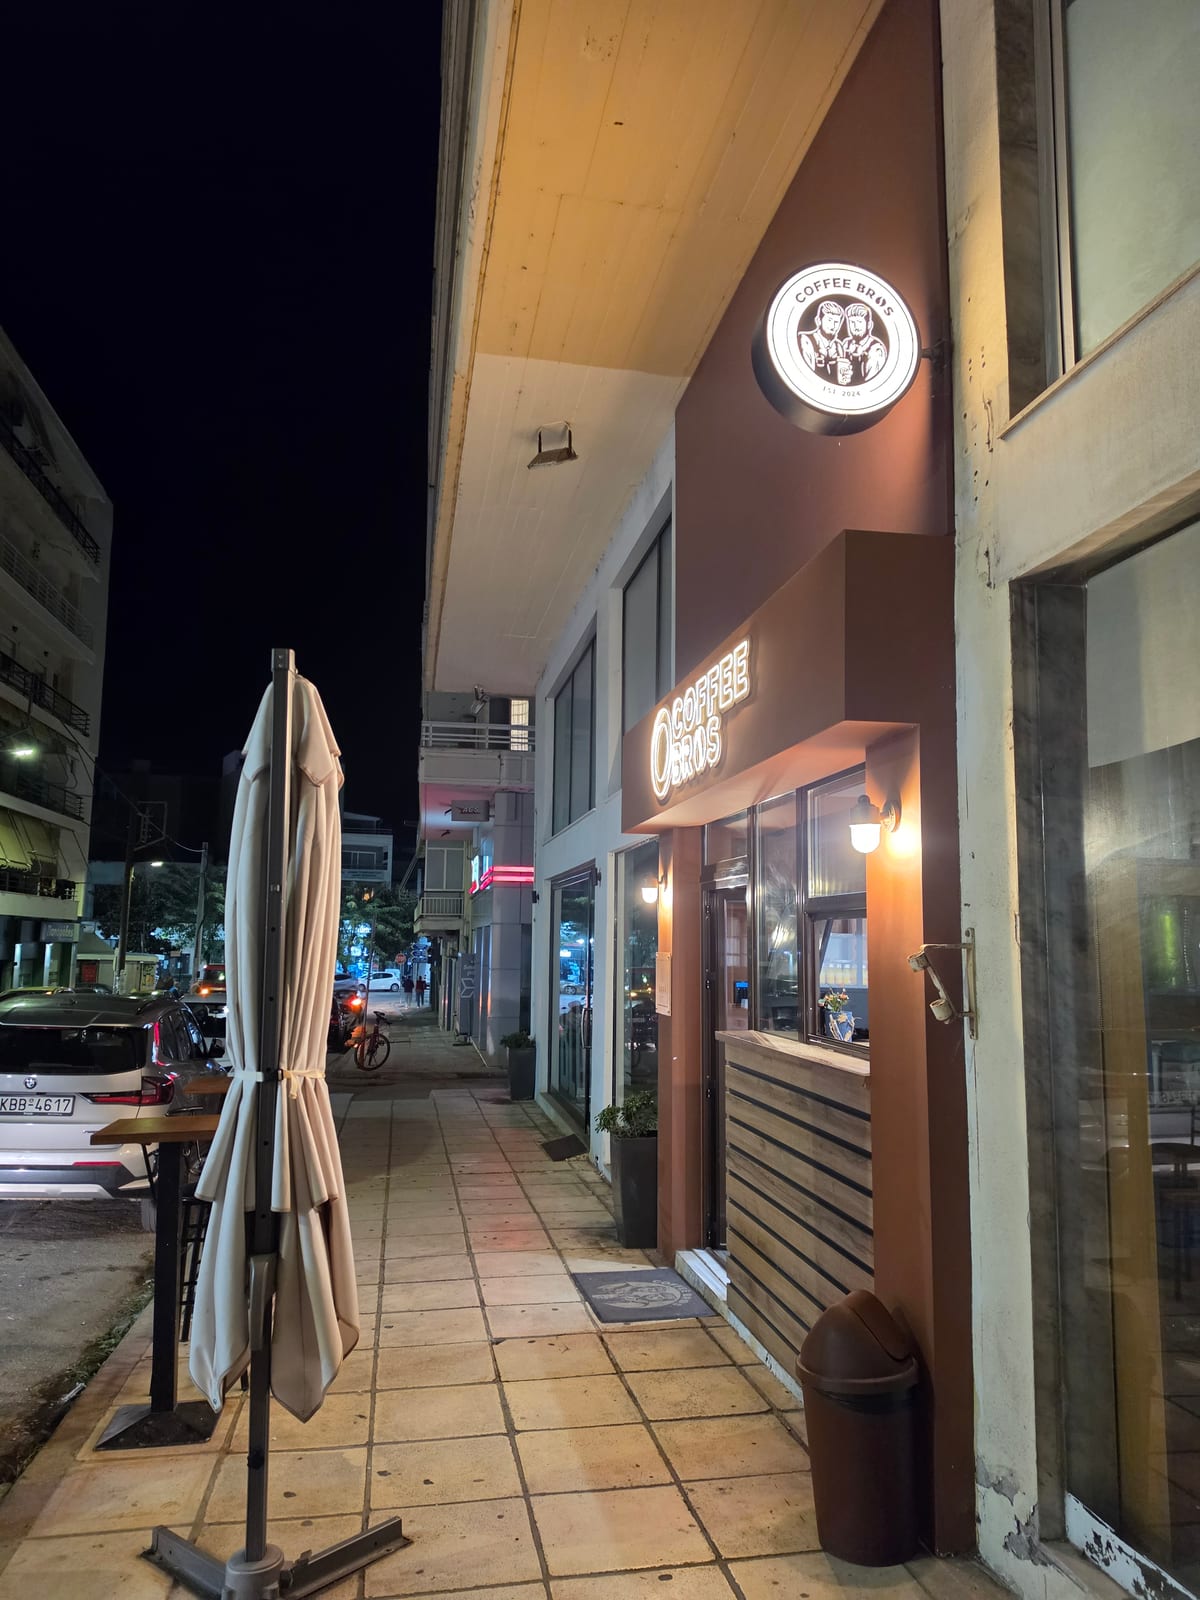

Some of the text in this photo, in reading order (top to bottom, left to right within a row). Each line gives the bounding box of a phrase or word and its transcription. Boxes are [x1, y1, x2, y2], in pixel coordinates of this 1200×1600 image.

[795, 277, 894, 316] COFFEE BROS
[671, 639, 749, 739] COFFEE
[670, 715, 721, 786] BROS
